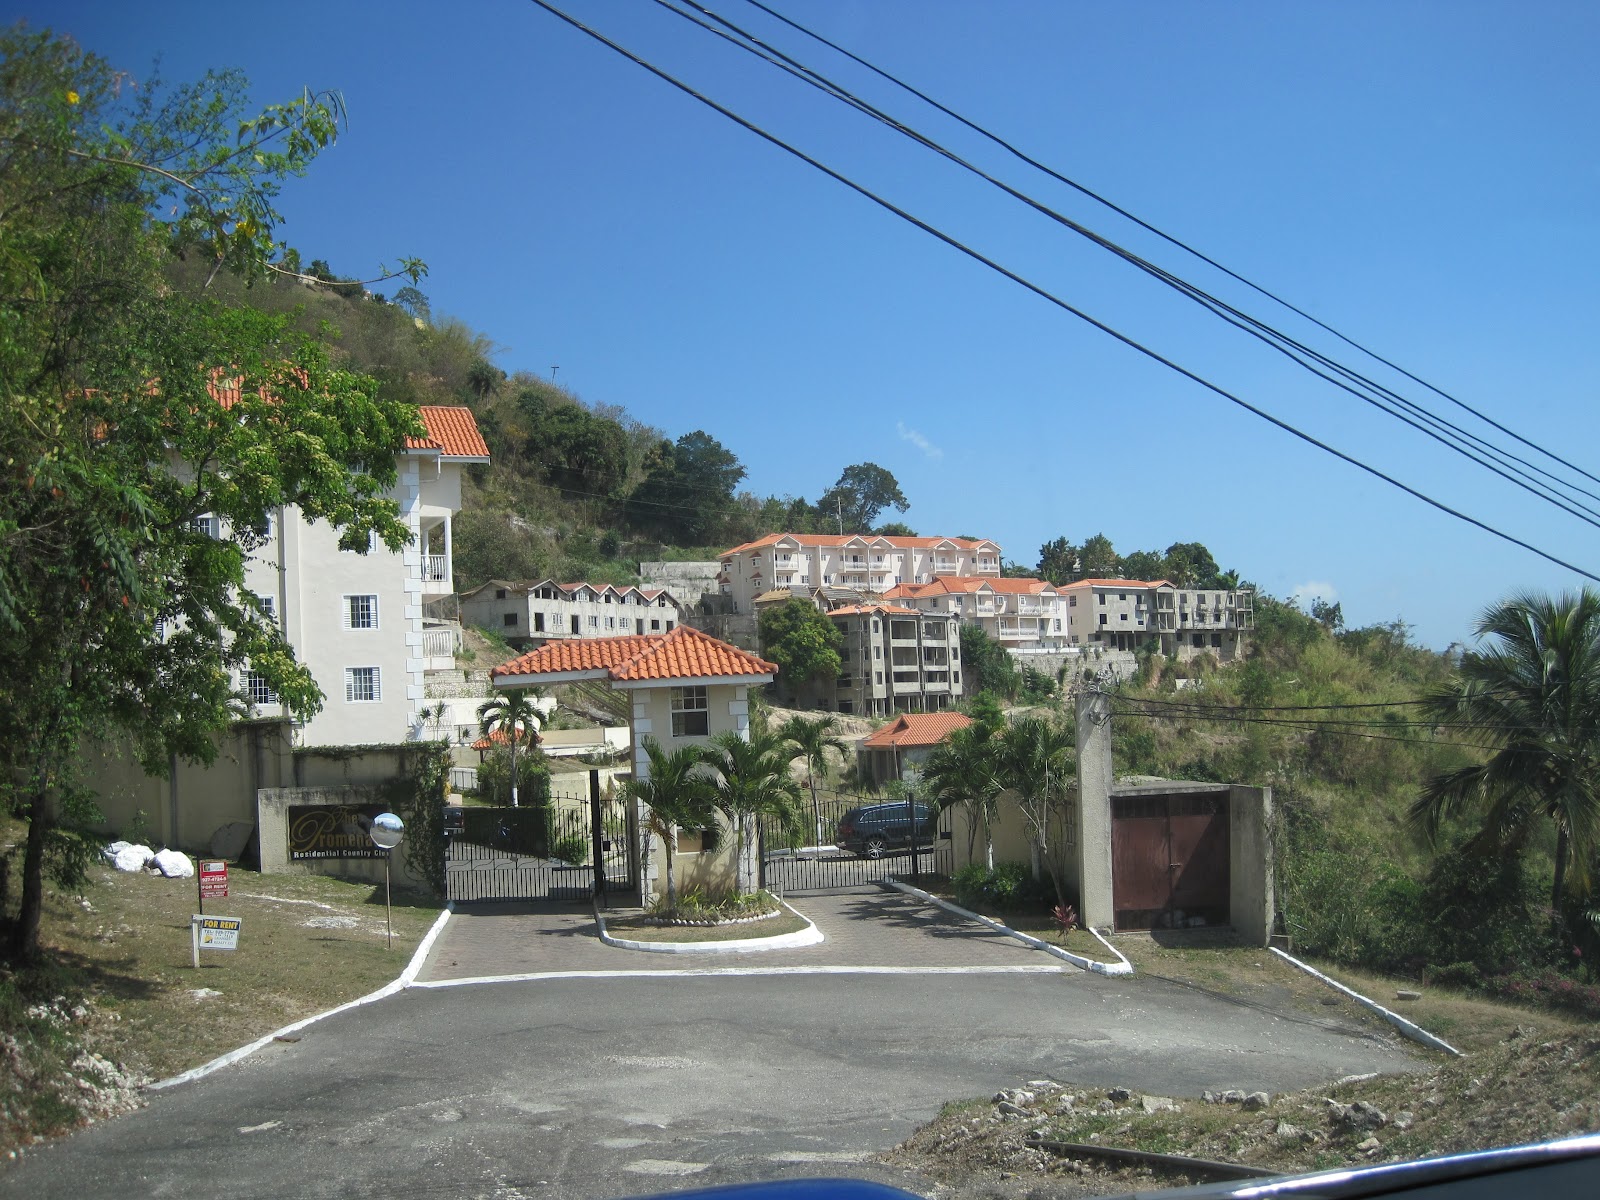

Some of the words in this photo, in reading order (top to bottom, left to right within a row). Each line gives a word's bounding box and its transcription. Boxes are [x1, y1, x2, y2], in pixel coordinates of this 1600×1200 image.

[330, 805, 359, 826] The
[294, 850, 340, 858] Residential
[342, 850, 371, 858] Country
[204, 920, 218, 928] FOR
